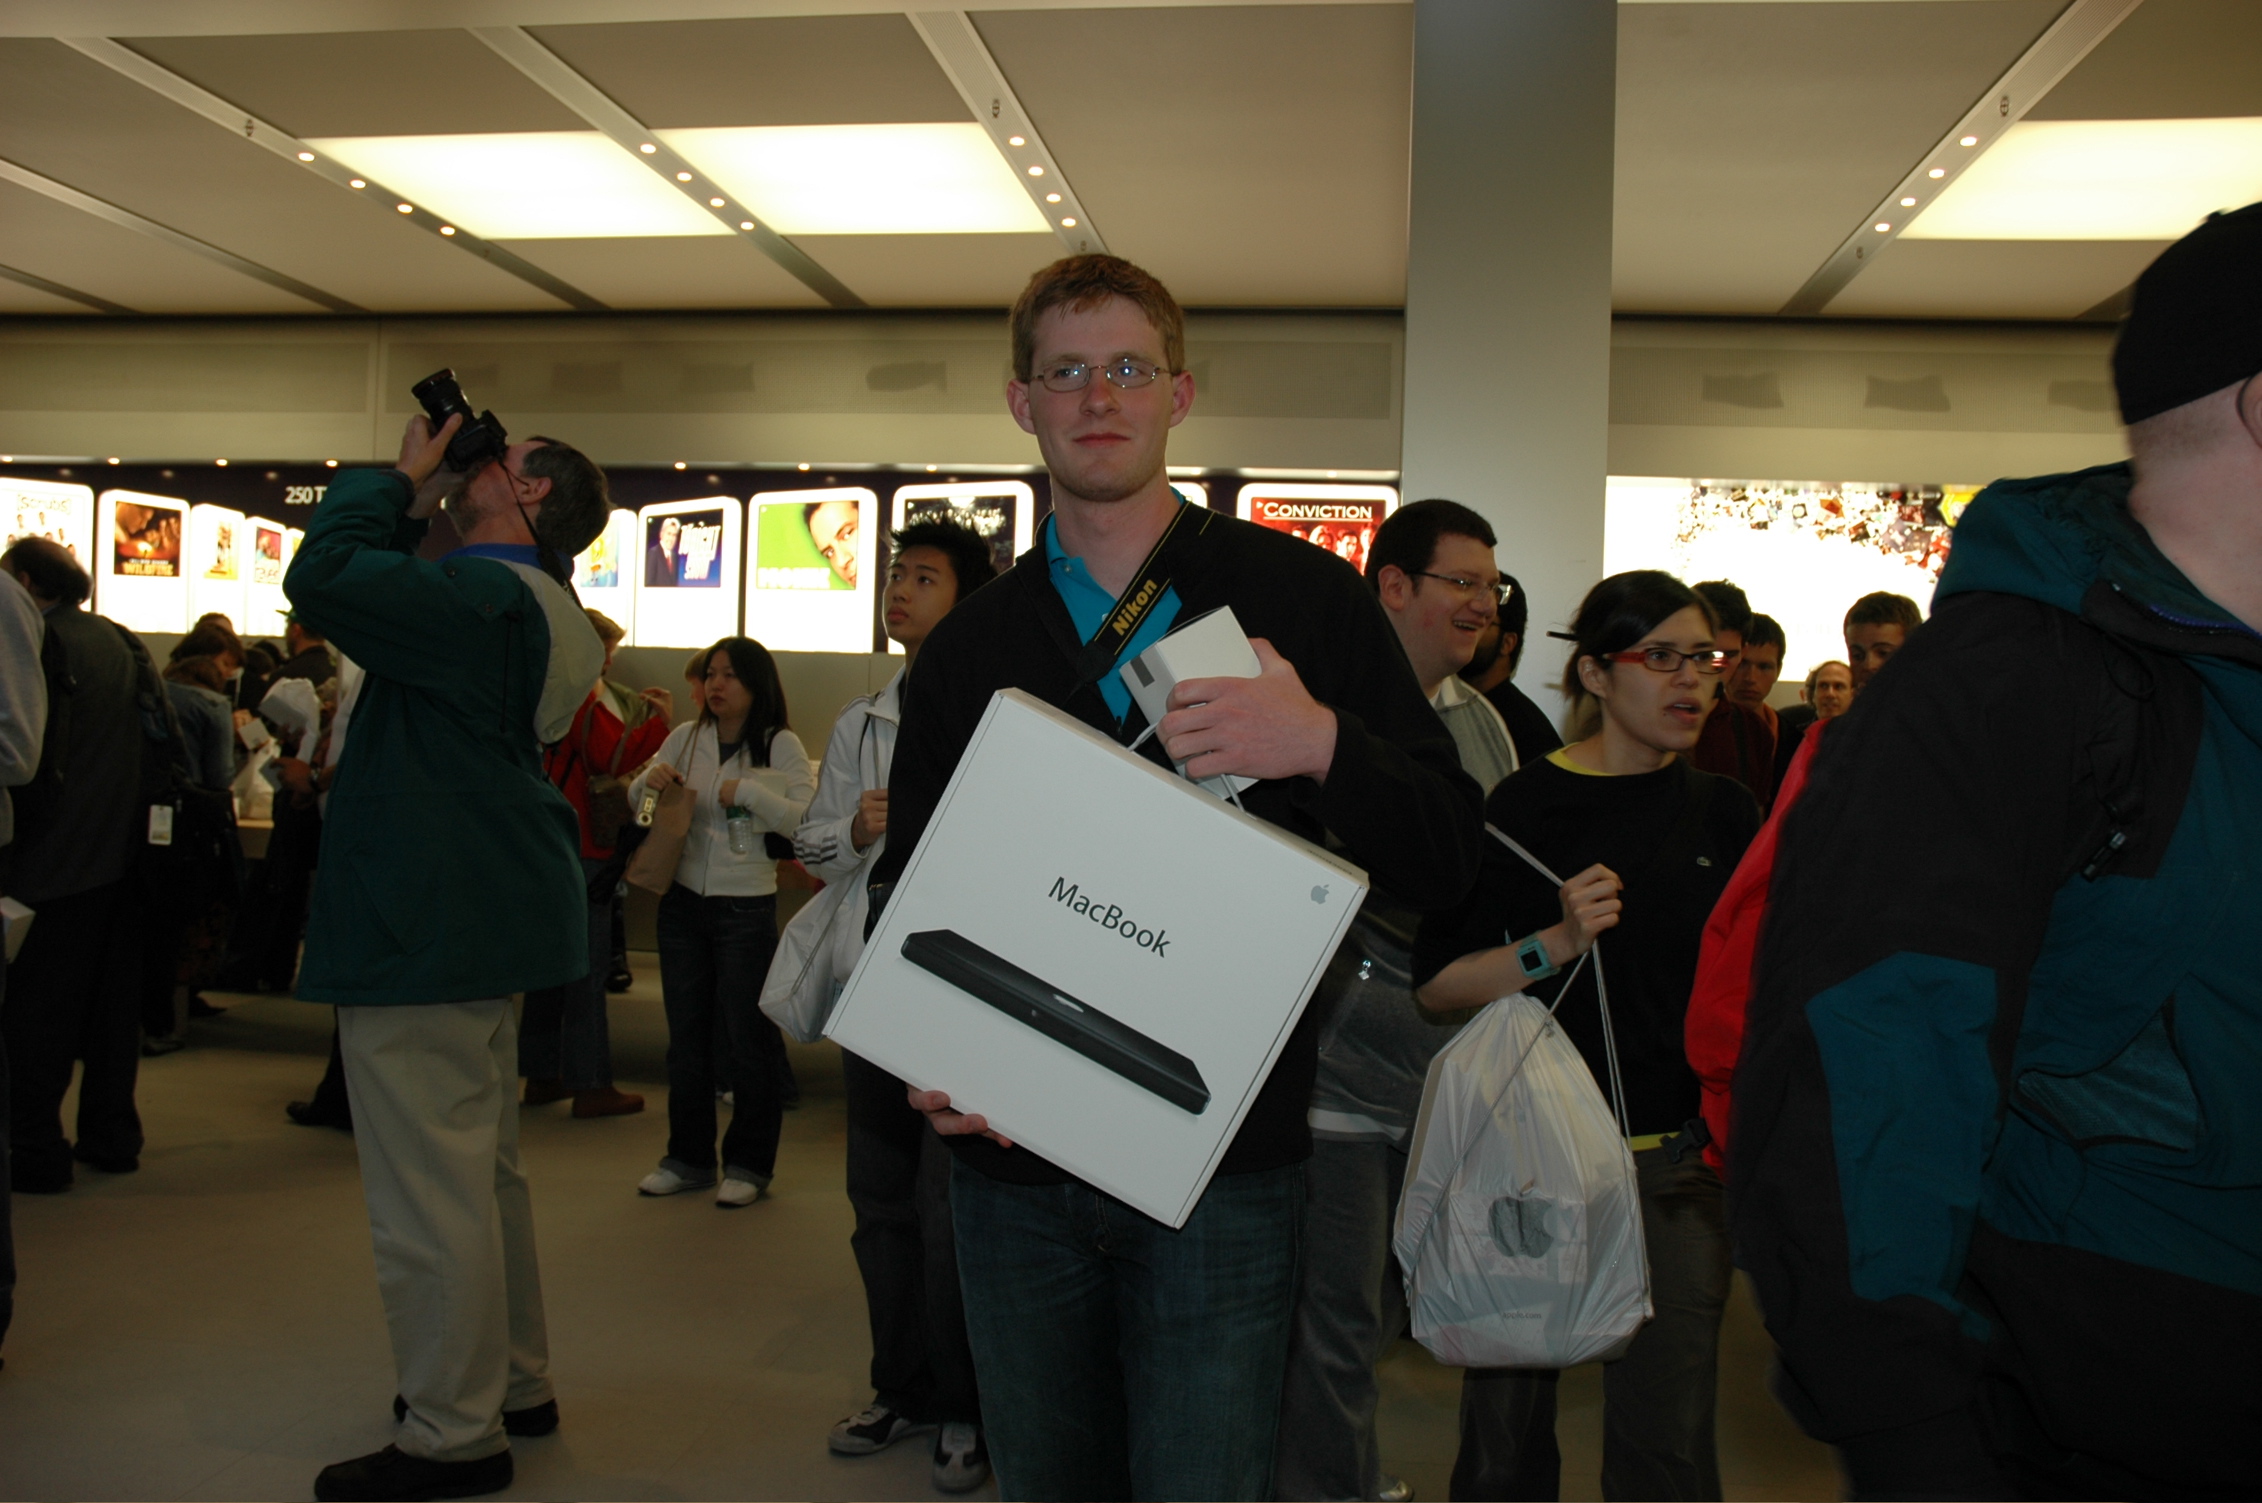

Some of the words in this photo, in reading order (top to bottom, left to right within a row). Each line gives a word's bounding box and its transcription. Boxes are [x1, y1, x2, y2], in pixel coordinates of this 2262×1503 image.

[284, 486, 314, 504] 250
[1263, 501, 1373, 519] CONVICTION
[1112, 579, 1158, 636] Nikon
[1048, 876, 1171, 958] MacBook
[1502, 1311, 1542, 1319] apple.com
